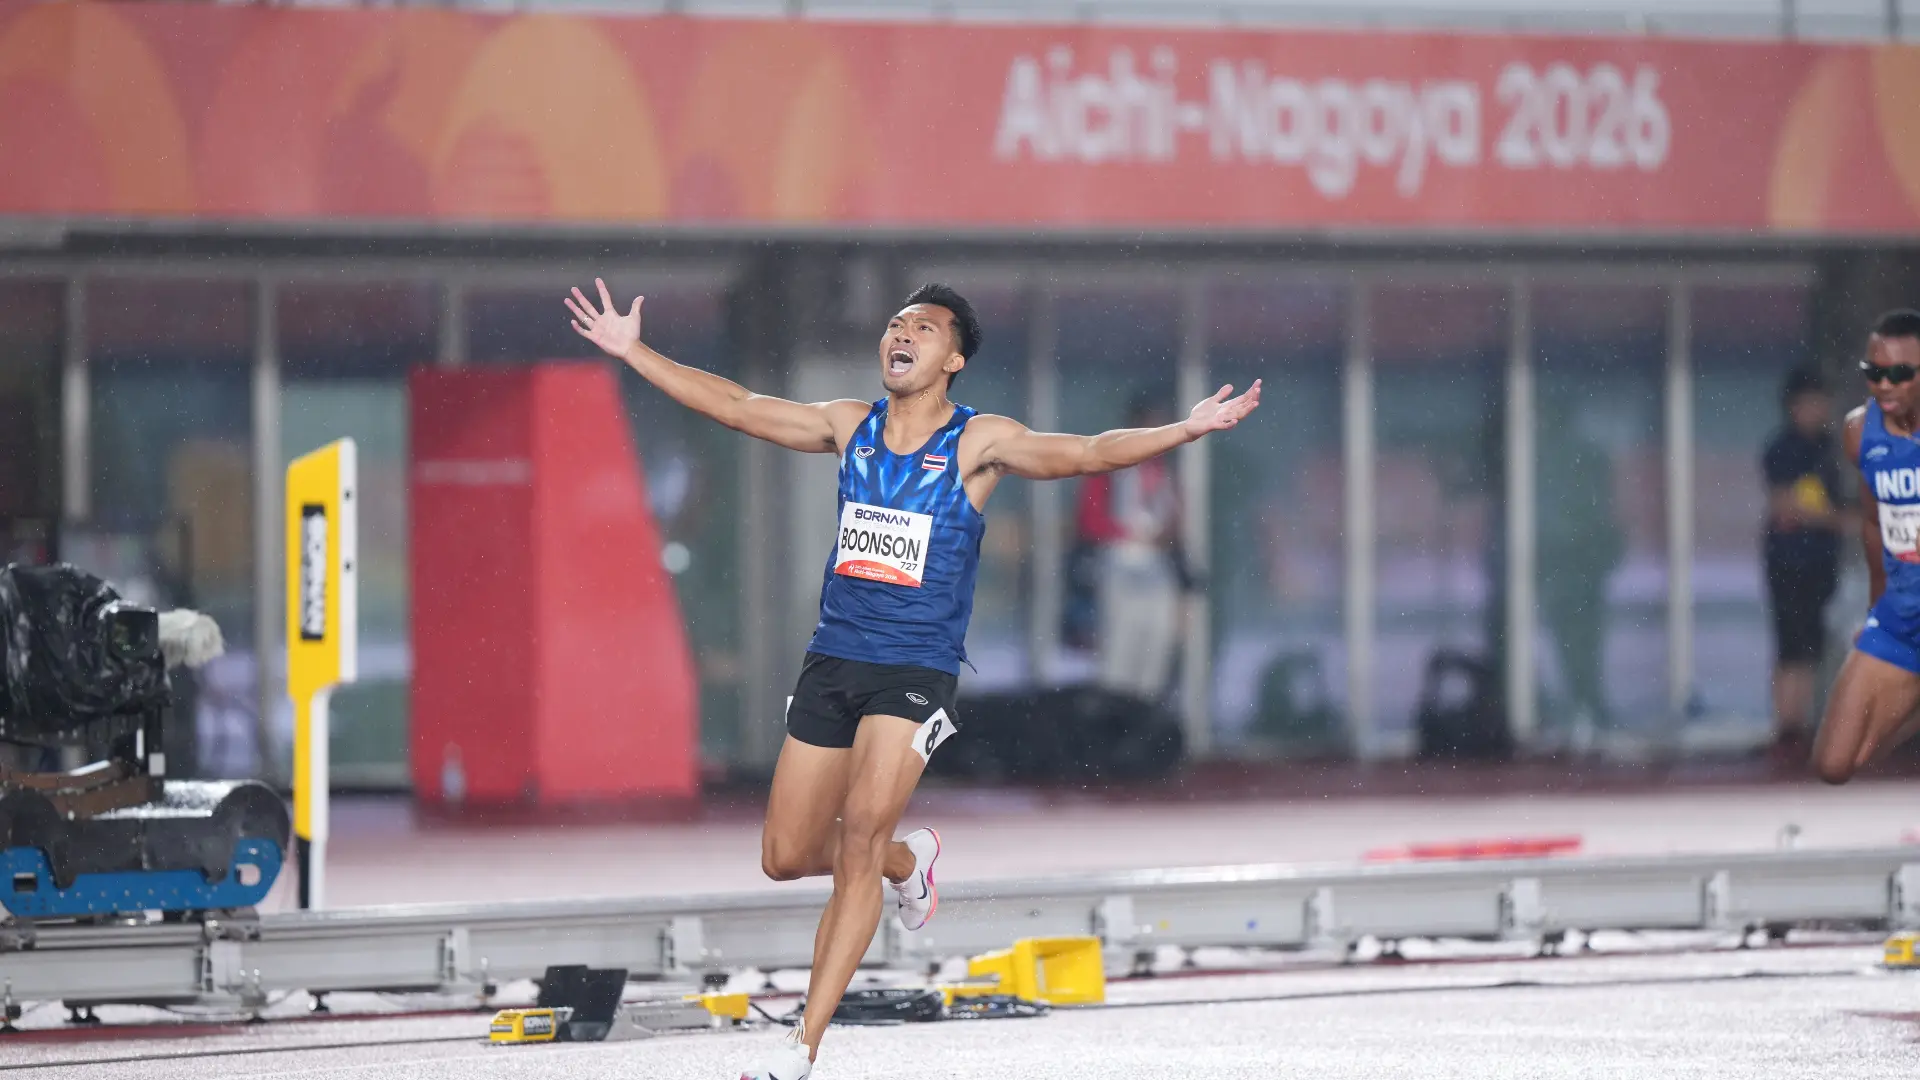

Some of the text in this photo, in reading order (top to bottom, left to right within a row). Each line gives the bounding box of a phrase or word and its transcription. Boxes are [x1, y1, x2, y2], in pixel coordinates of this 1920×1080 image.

[997, 46, 1669, 197] Aichi-Nagoya 2026
[855, 508, 910, 527] BORNAN
[841, 527, 920, 561] BOONSON
[900, 561, 917, 572] 727
[925, 719, 943, 755] 8
